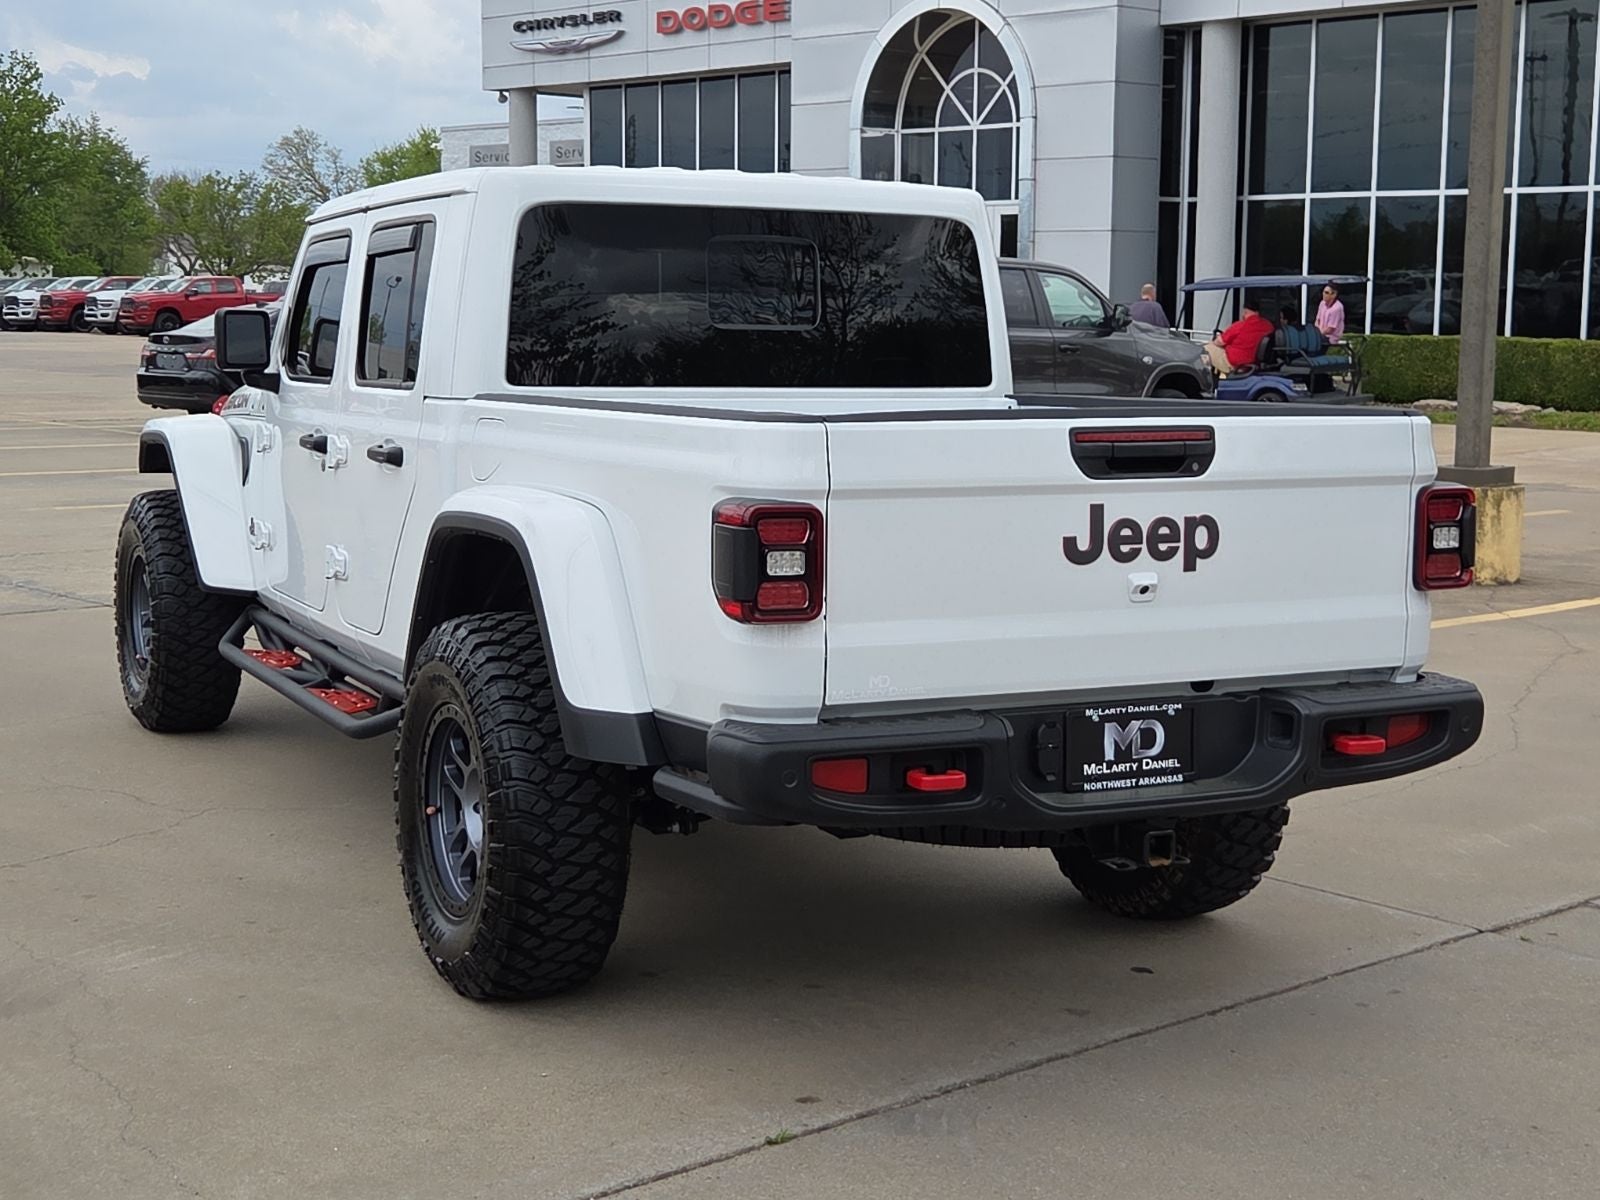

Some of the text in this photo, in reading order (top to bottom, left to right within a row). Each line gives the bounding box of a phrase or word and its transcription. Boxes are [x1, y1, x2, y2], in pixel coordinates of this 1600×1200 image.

[513, 10, 622, 33] CHRYSLER
[656, 0, 791, 35] DODGE
[474, 150, 510, 163] Servic
[555, 145, 584, 160] Serv
[1062, 503, 1220, 572] Jeep
[1127, 703, 1182, 714] DANIEL.COM
[1104, 719, 1165, 761] MD
[1142, 758, 1181, 770] DANIEL
[1083, 774, 1184, 791] NORTHWEST ARKANSAS
